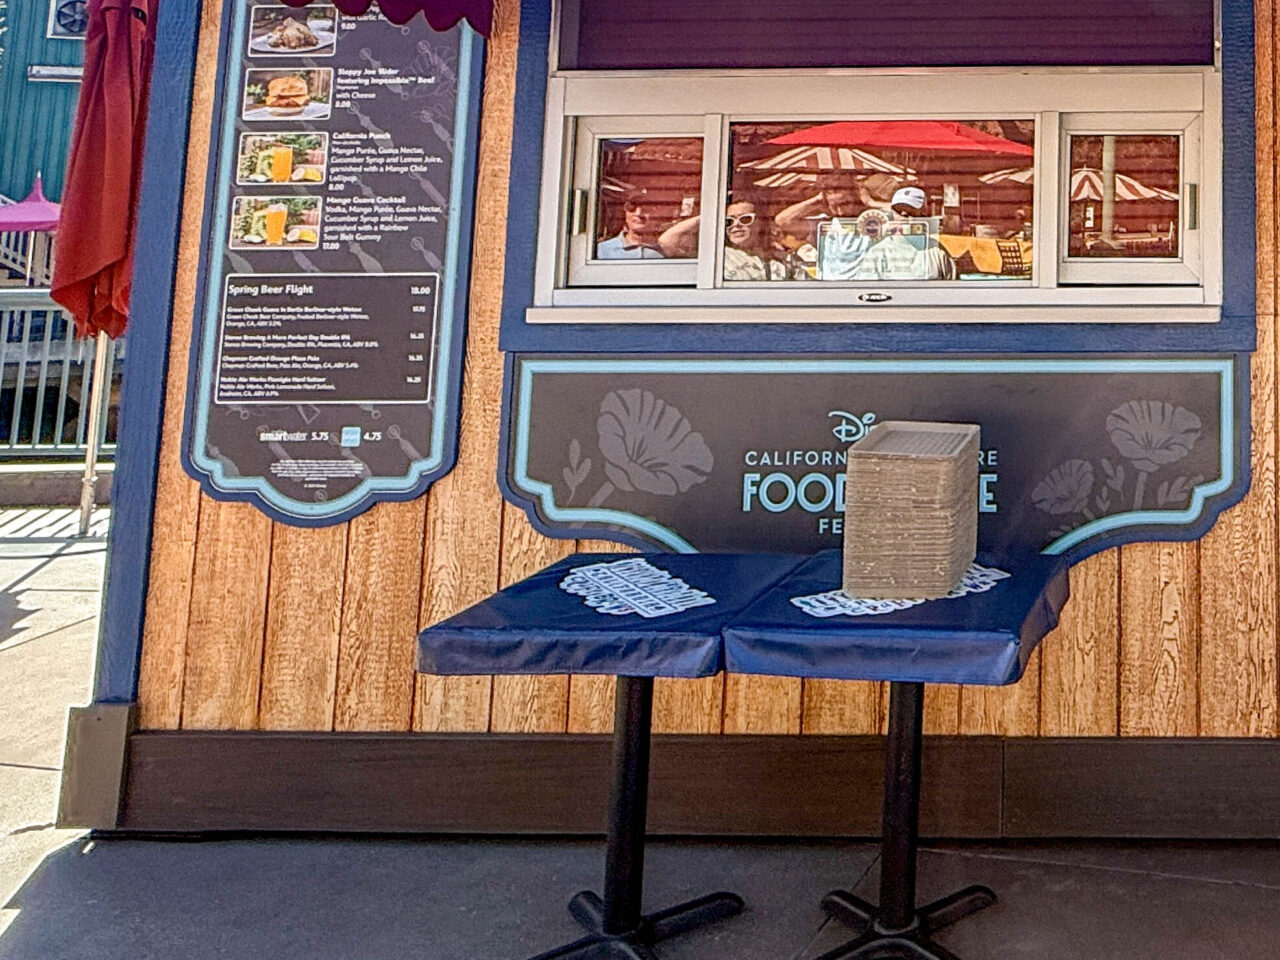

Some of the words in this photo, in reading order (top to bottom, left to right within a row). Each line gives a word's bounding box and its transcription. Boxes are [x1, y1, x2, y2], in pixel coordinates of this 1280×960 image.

[327, 197, 351, 205] Mango
[355, 234, 381, 242] Gummy
[229, 285, 258, 296] Spring
[261, 285, 283, 293] Beer
[285, 285, 313, 296] Flight
[311, 432, 329, 440] 5.75
[363, 432, 382, 440] 4.75
[744, 451, 847, 466] CALIFORN
